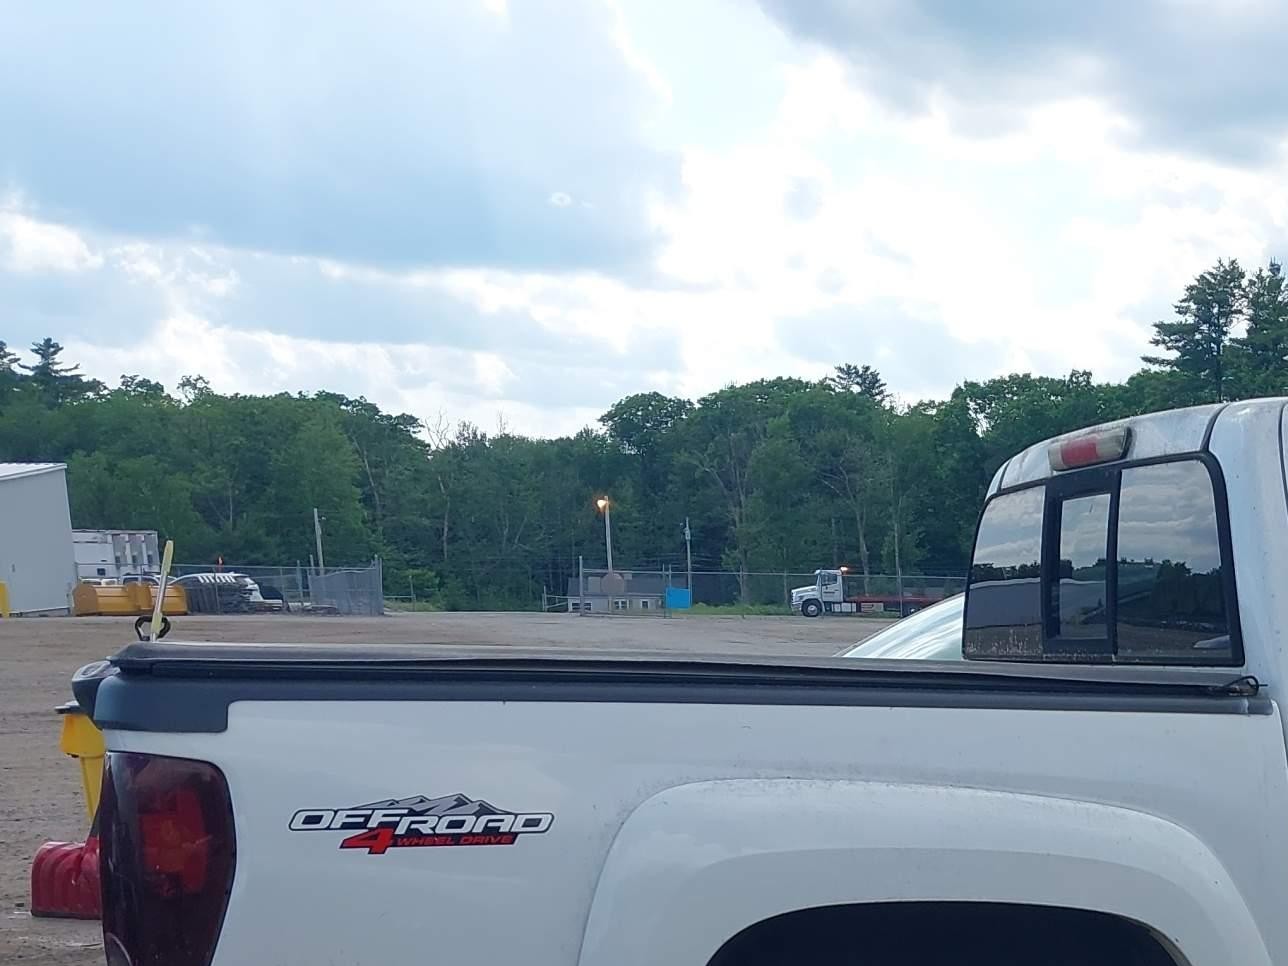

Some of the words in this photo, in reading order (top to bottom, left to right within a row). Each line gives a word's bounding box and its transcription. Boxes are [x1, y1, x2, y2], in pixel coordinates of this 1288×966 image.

[339, 827, 396, 855] 4
[397, 836, 455, 846] WHEEL
[459, 834, 516, 845] DRIVE
